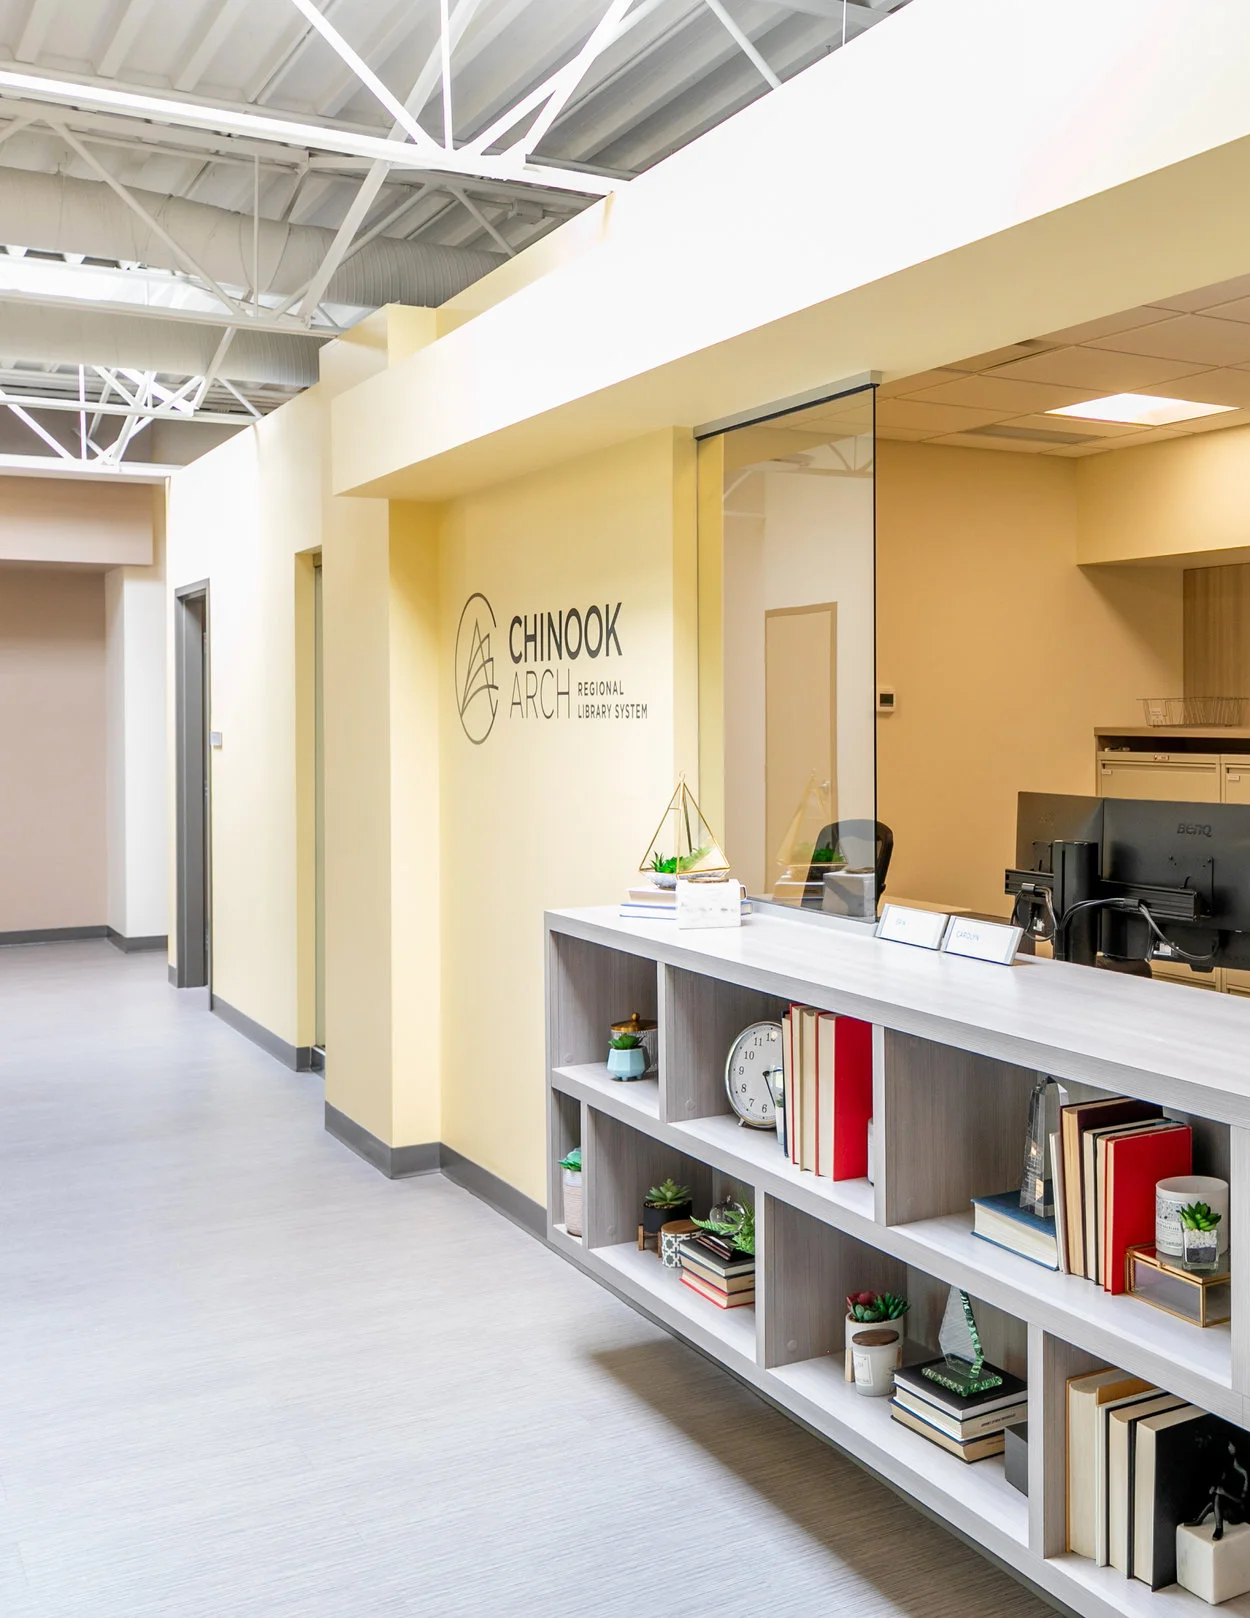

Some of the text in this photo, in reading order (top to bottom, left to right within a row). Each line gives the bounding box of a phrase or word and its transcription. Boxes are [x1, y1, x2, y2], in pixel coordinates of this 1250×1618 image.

[508, 602, 623, 664] CHINOOK
[577, 680, 625, 696] REGIONAL
[510, 668, 570, 719] ARCH
[577, 703, 648, 719] LIBRARY SYSTEM
[754, 1037, 762, 1046] 11
[744, 1051, 755, 1060] 10
[738, 1066, 744, 1075] 9
[741, 1083, 747, 1093] 8
[749, 1098, 755, 1108] 7
[761, 1104, 768, 1113] 6
